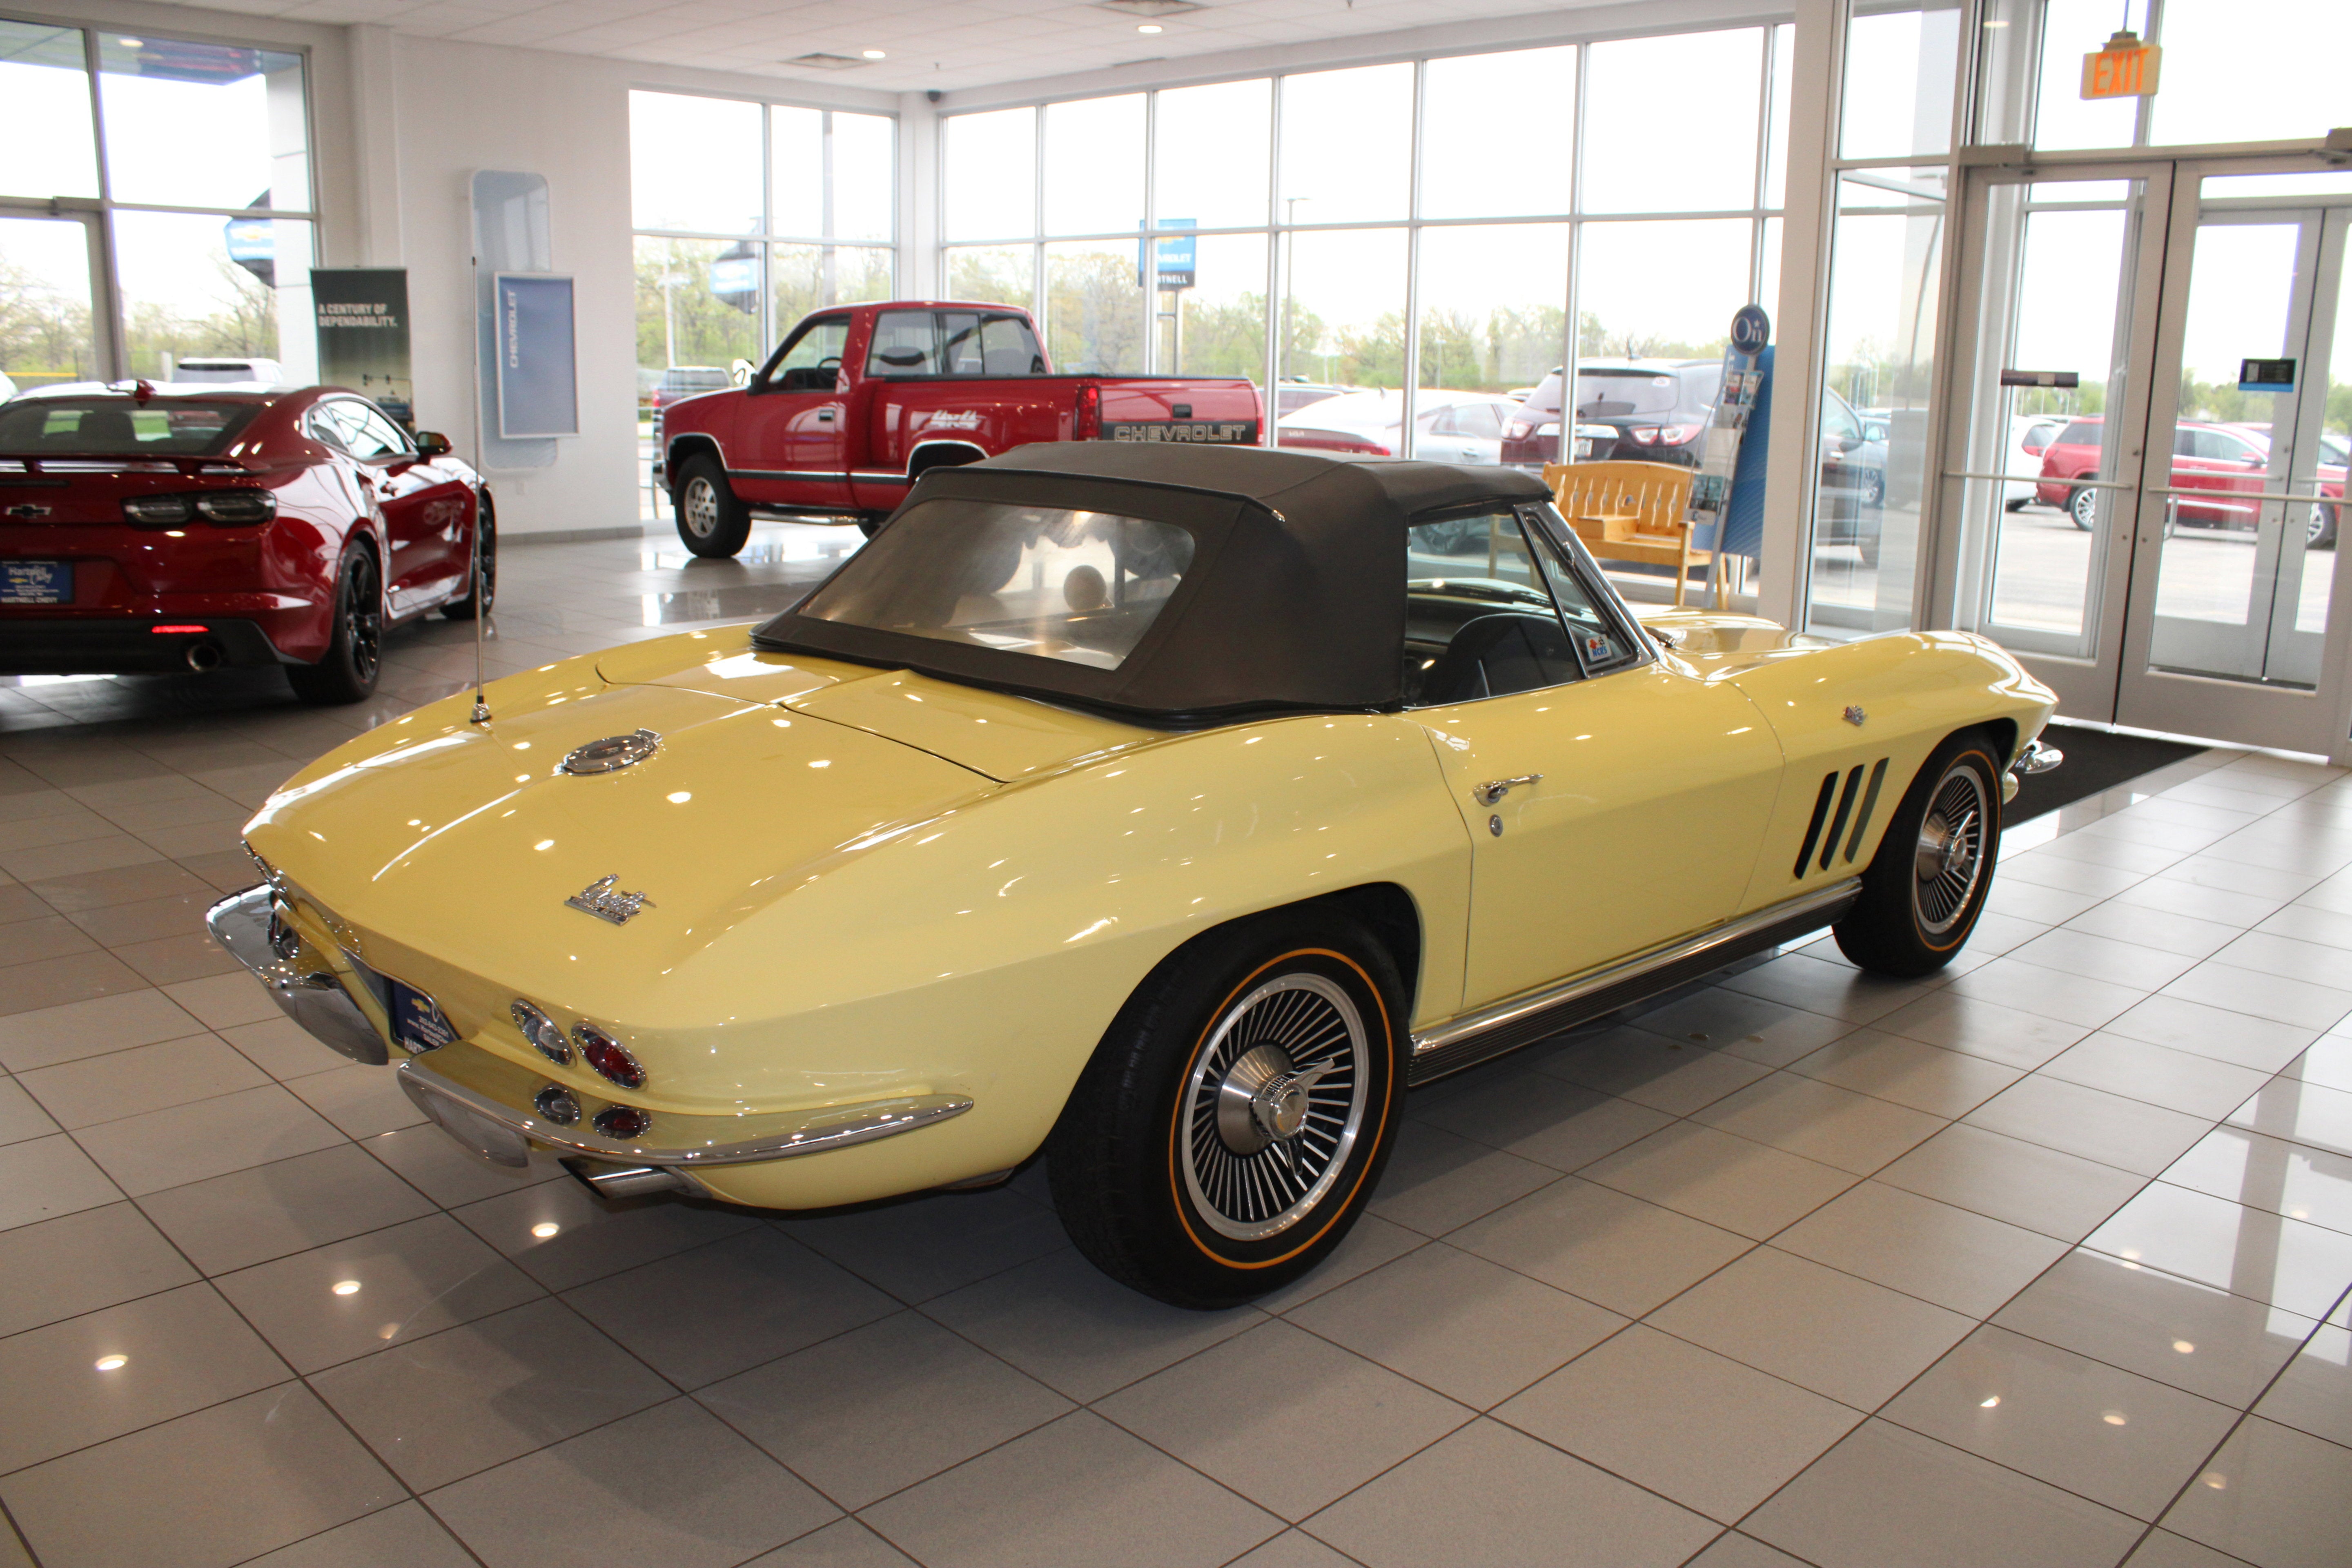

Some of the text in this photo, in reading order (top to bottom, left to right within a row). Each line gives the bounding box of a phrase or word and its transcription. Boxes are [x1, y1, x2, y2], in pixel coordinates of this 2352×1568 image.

[2093, 49, 2149, 95] EXIT
[318, 303, 387, 314] A CENTURY OF
[318, 316, 398, 327] DEPENDABILITY.
[508, 290, 519, 368] CHEVROLET
[1114, 425, 1245, 441] CHEVROLET
[1592, 646, 1607, 657] NCRS
